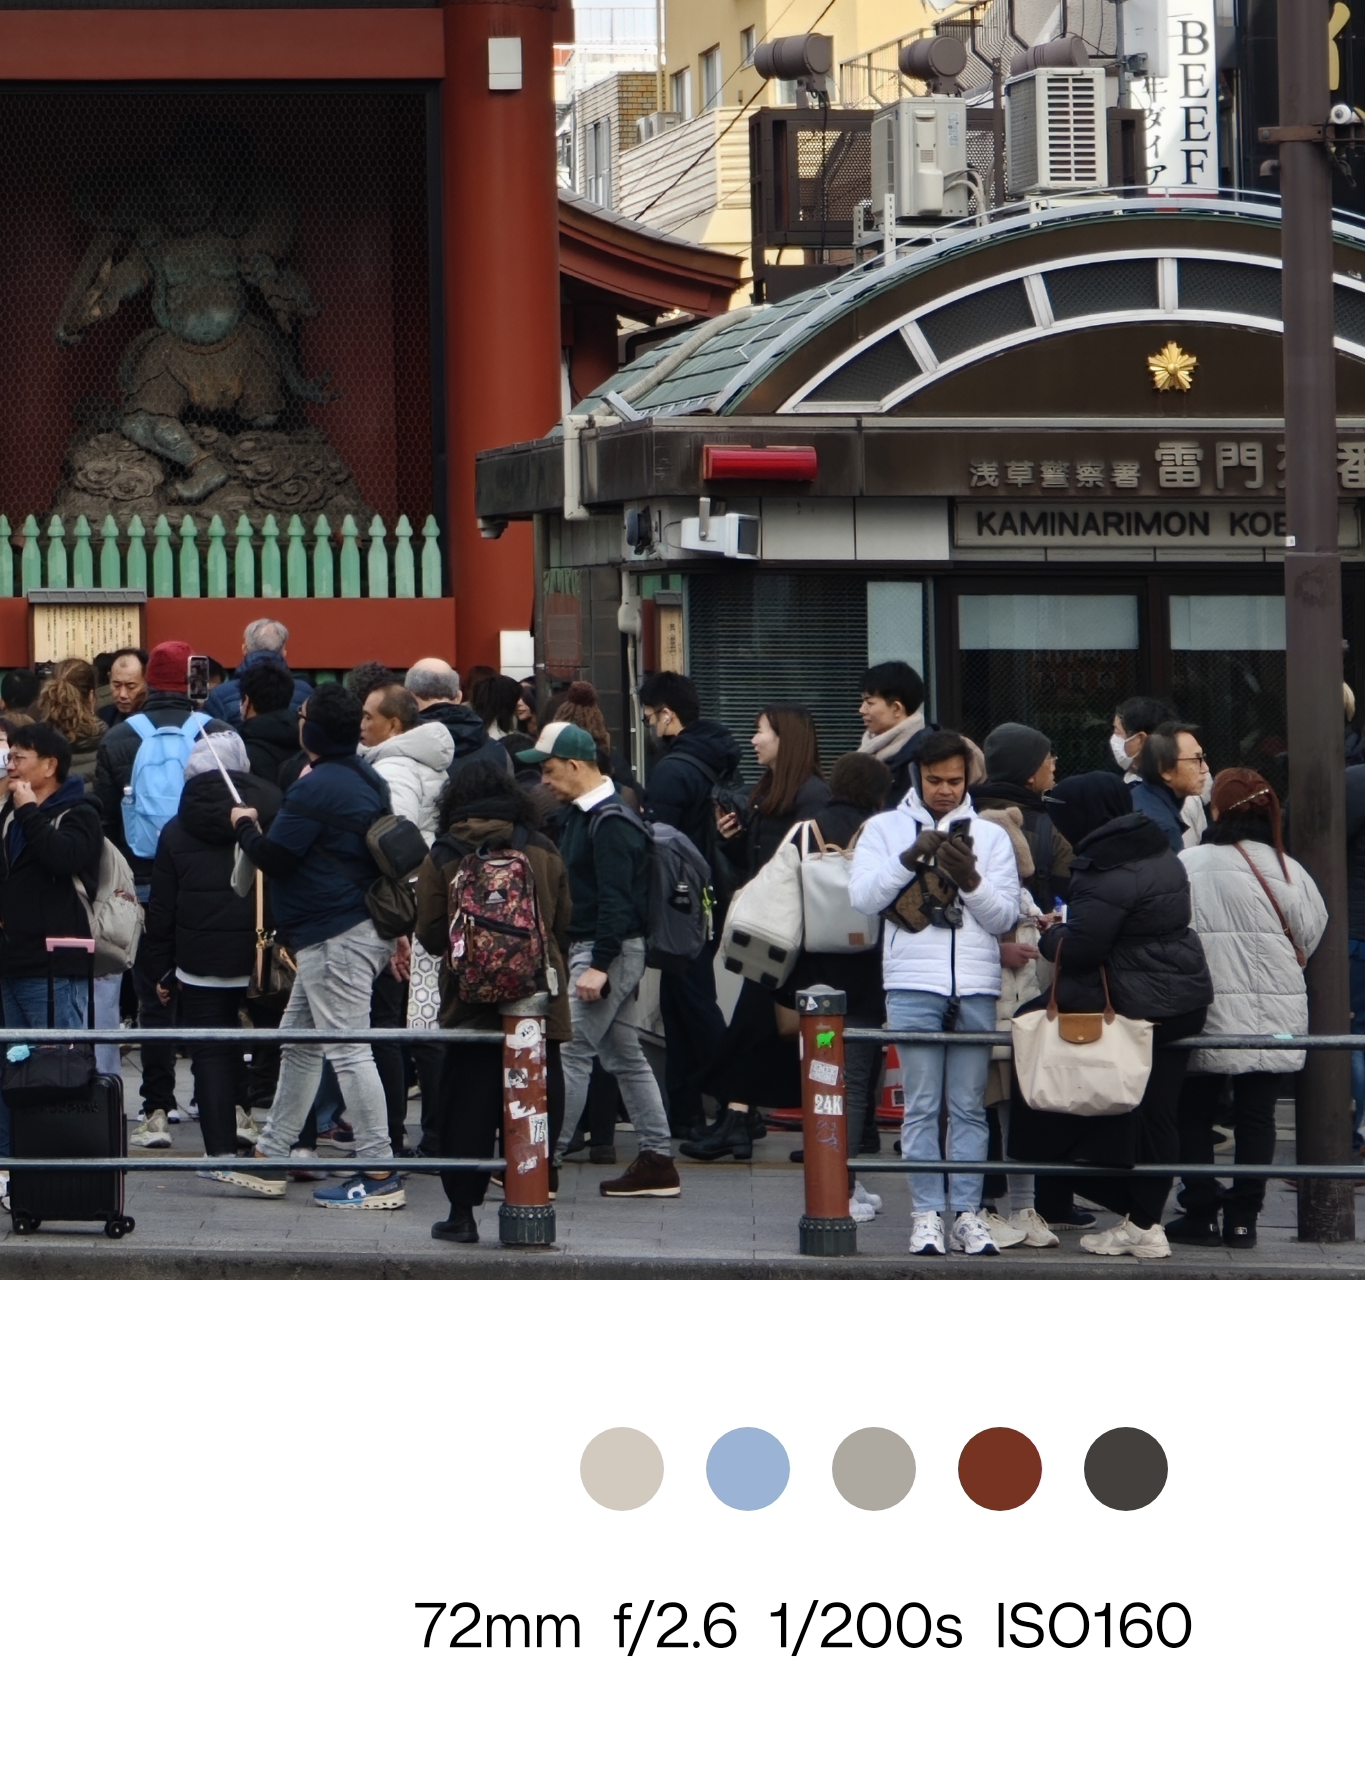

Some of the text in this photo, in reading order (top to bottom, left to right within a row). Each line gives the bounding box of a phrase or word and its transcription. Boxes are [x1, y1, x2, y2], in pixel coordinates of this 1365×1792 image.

[1178, 20, 1211, 186] BEEF
[969, 460, 1142, 489] 浅草警察署
[976, 511, 1287, 538] KAMINARIMON KOB
[814, 1093, 843, 1115] 24K
